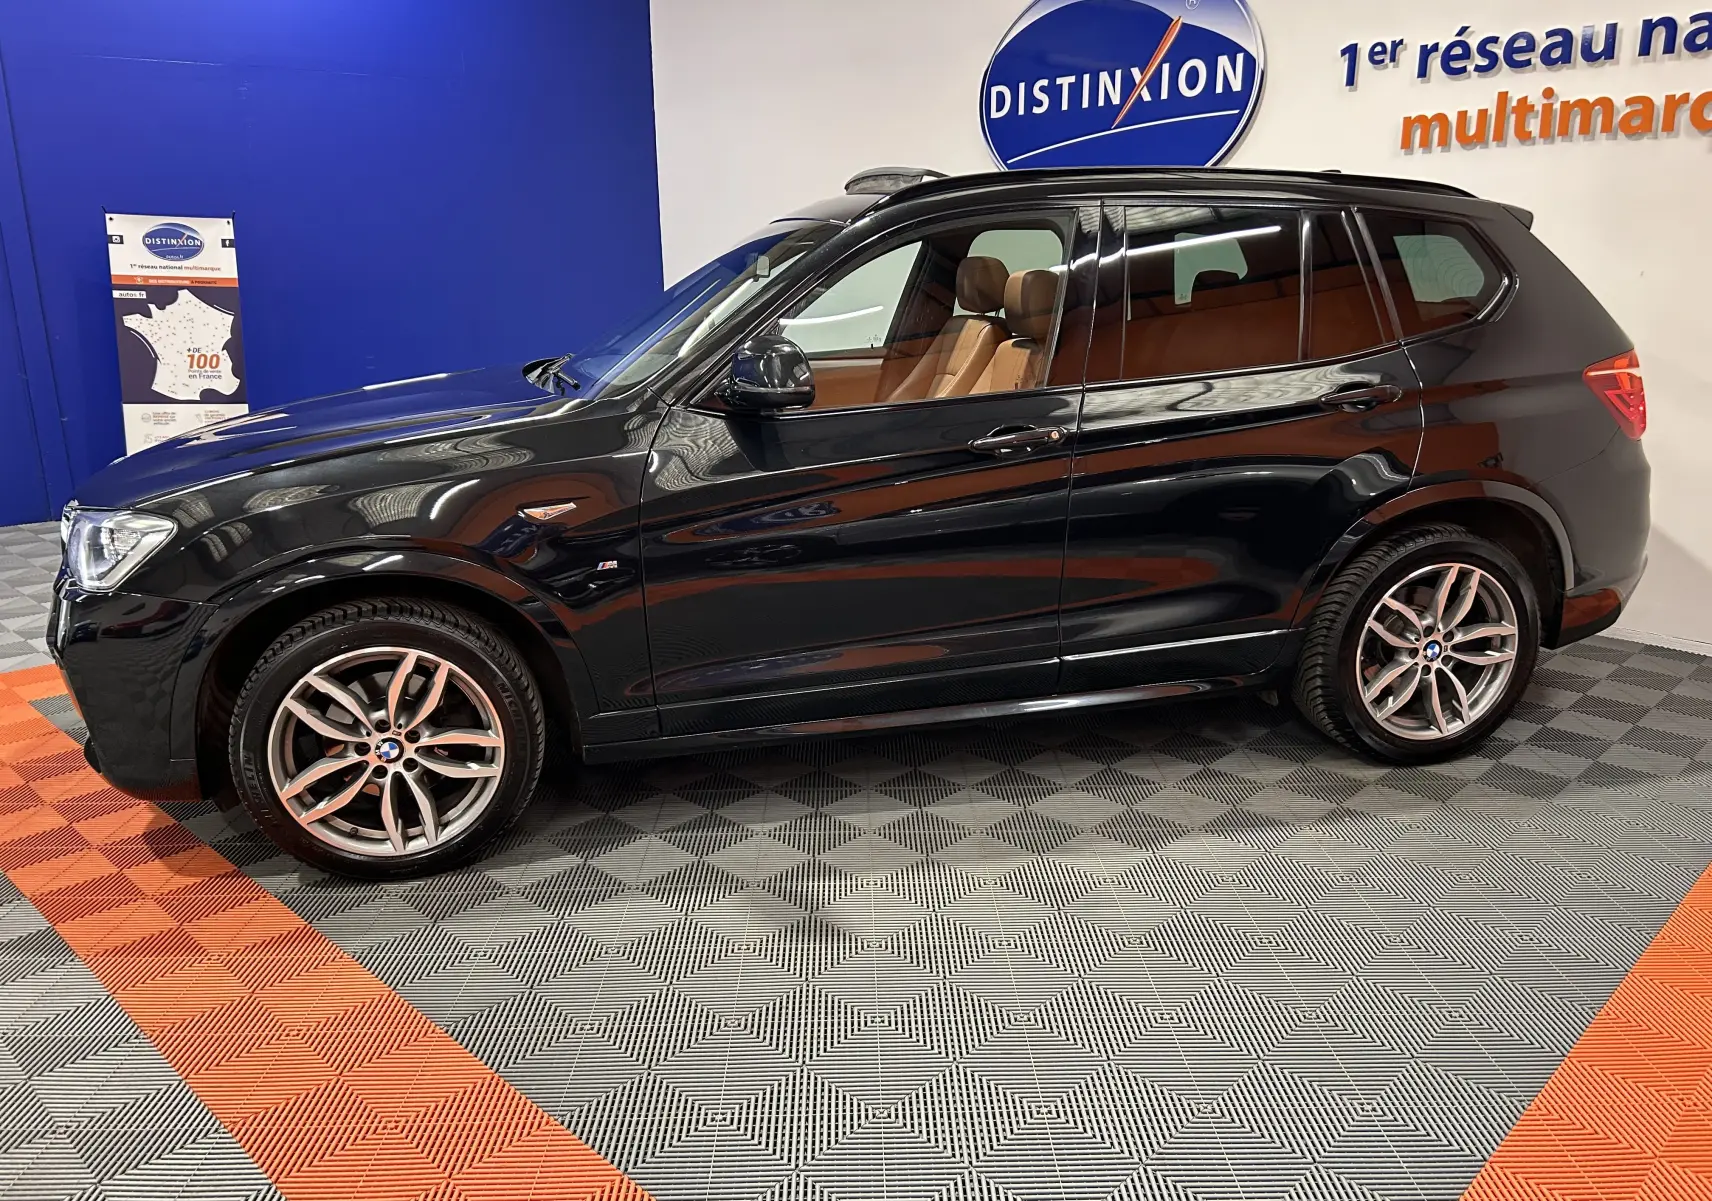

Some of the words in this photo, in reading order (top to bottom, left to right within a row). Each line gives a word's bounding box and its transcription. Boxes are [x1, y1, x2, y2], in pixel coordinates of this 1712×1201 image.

[1340, 37, 1403, 87] 1er
[1417, 22, 1618, 79] réseau
[989, 53, 1245, 119] DISTINXION
[145, 236, 201, 246] DISTINXION
[187, 353, 220, 369] 100
